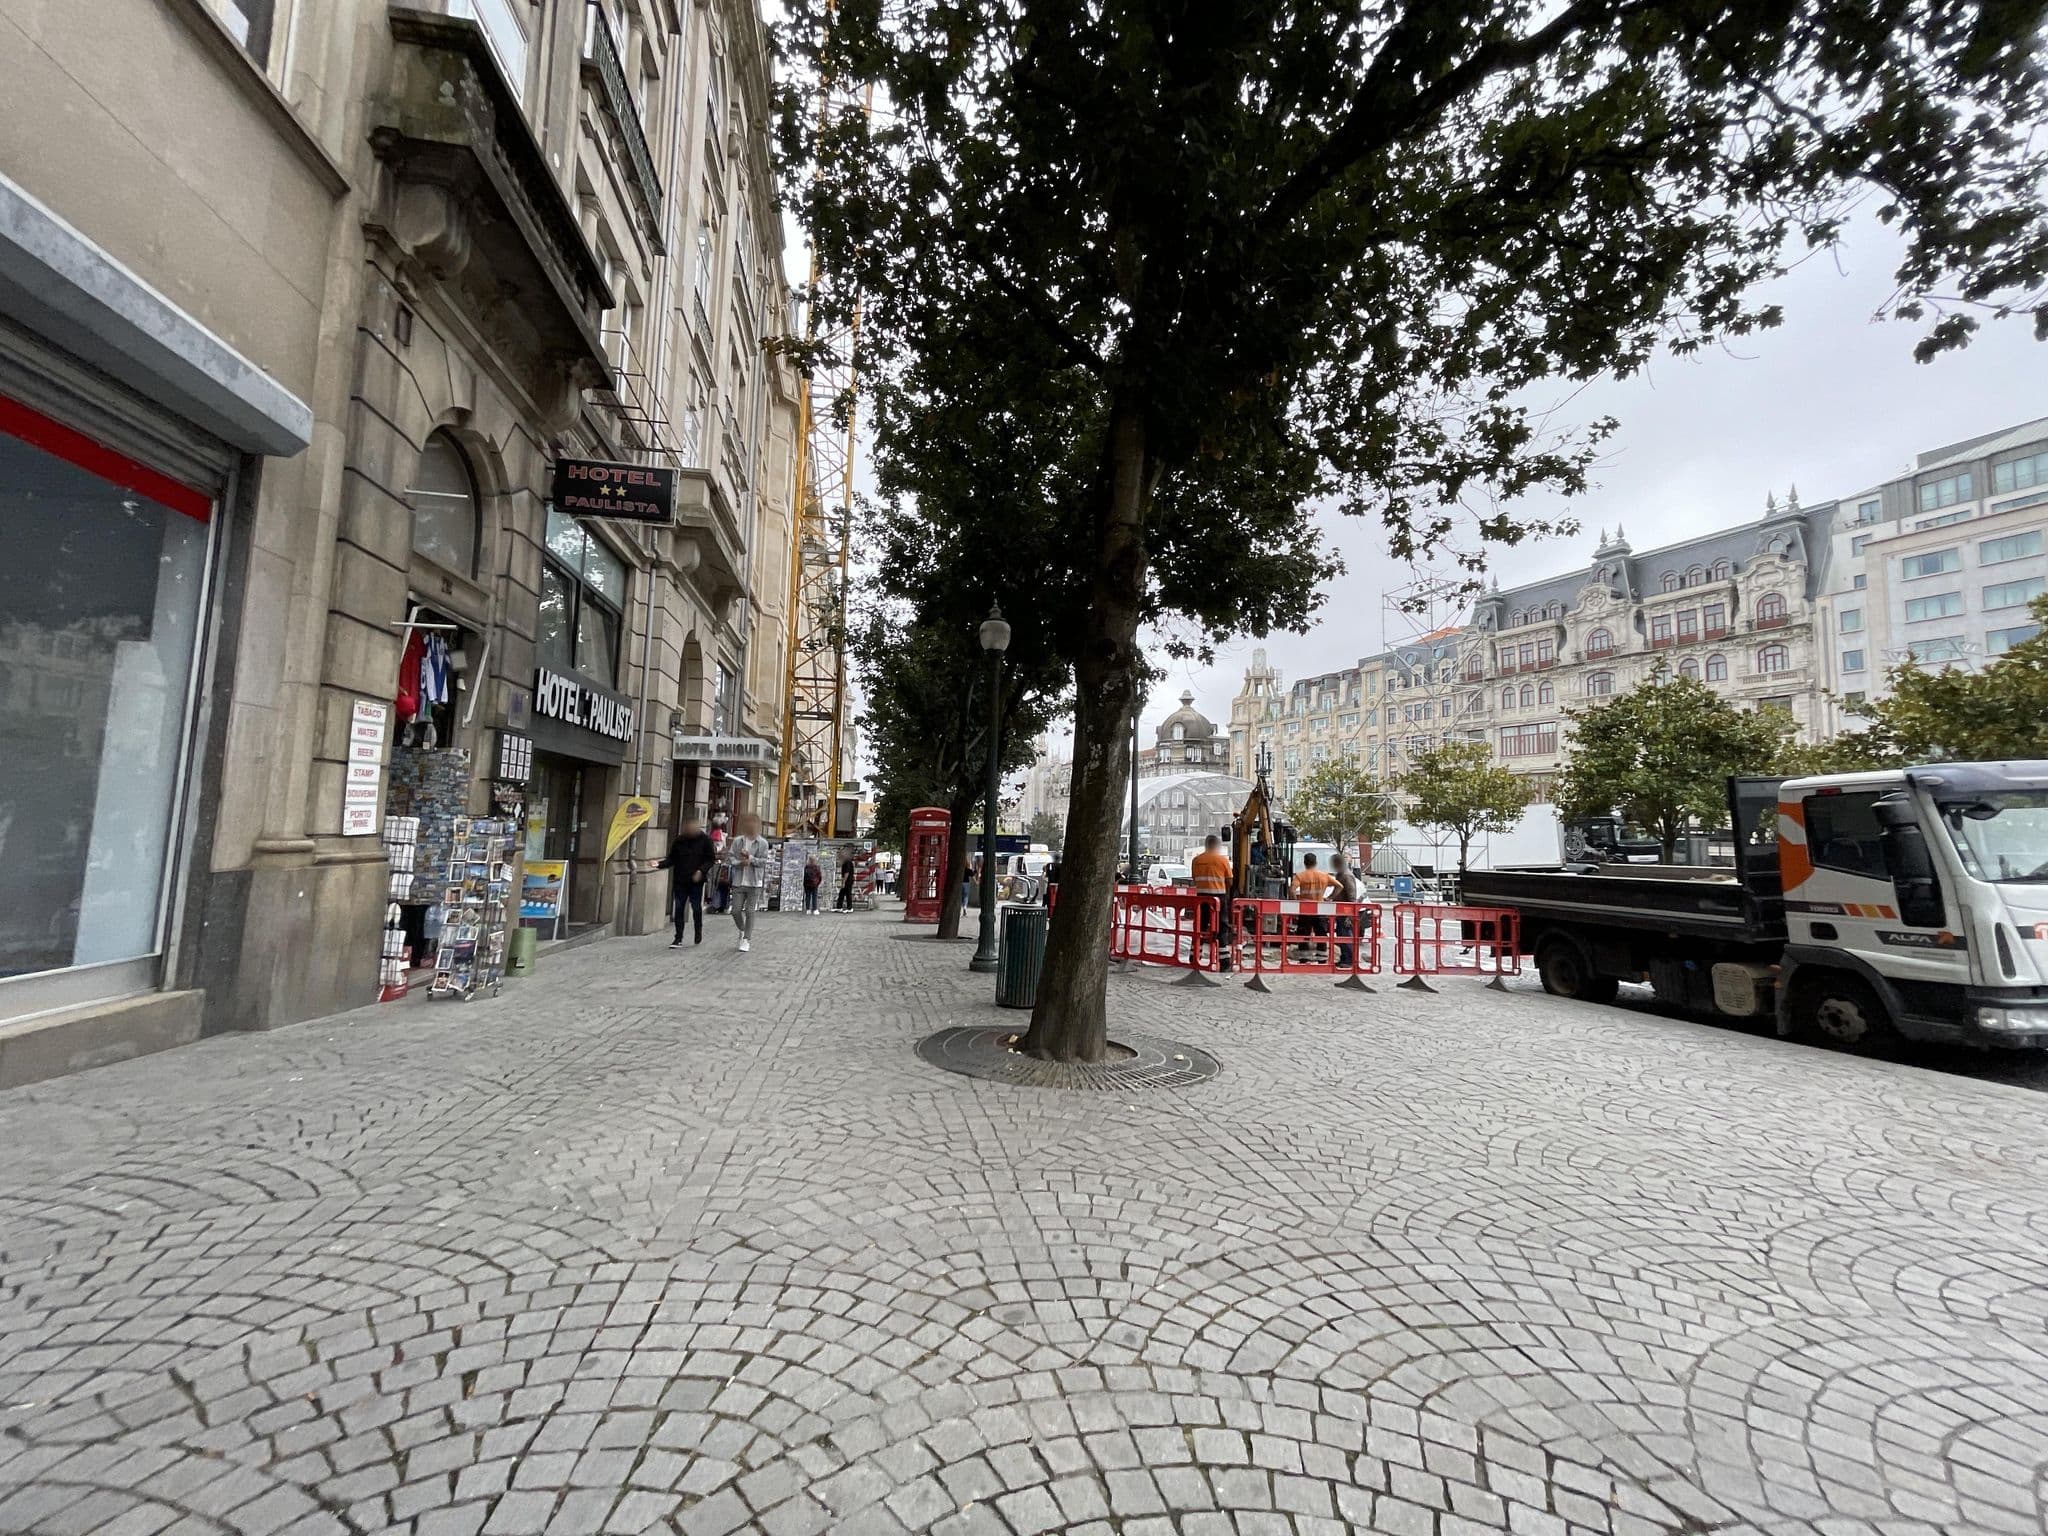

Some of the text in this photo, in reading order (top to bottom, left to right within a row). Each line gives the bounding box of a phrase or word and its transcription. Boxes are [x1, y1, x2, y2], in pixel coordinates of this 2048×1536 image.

[568, 465, 661, 487] HOTEL
[565, 495, 660, 514] PAULISTA
[536, 666, 634, 744] HOTEL PAULISTA
[358, 707, 381, 719] TABACO
[357, 727, 378, 738] WATER
[357, 747, 374, 757] BEER
[353, 768, 374, 777] STAMP
[1888, 933, 1932, 943] ALFA
